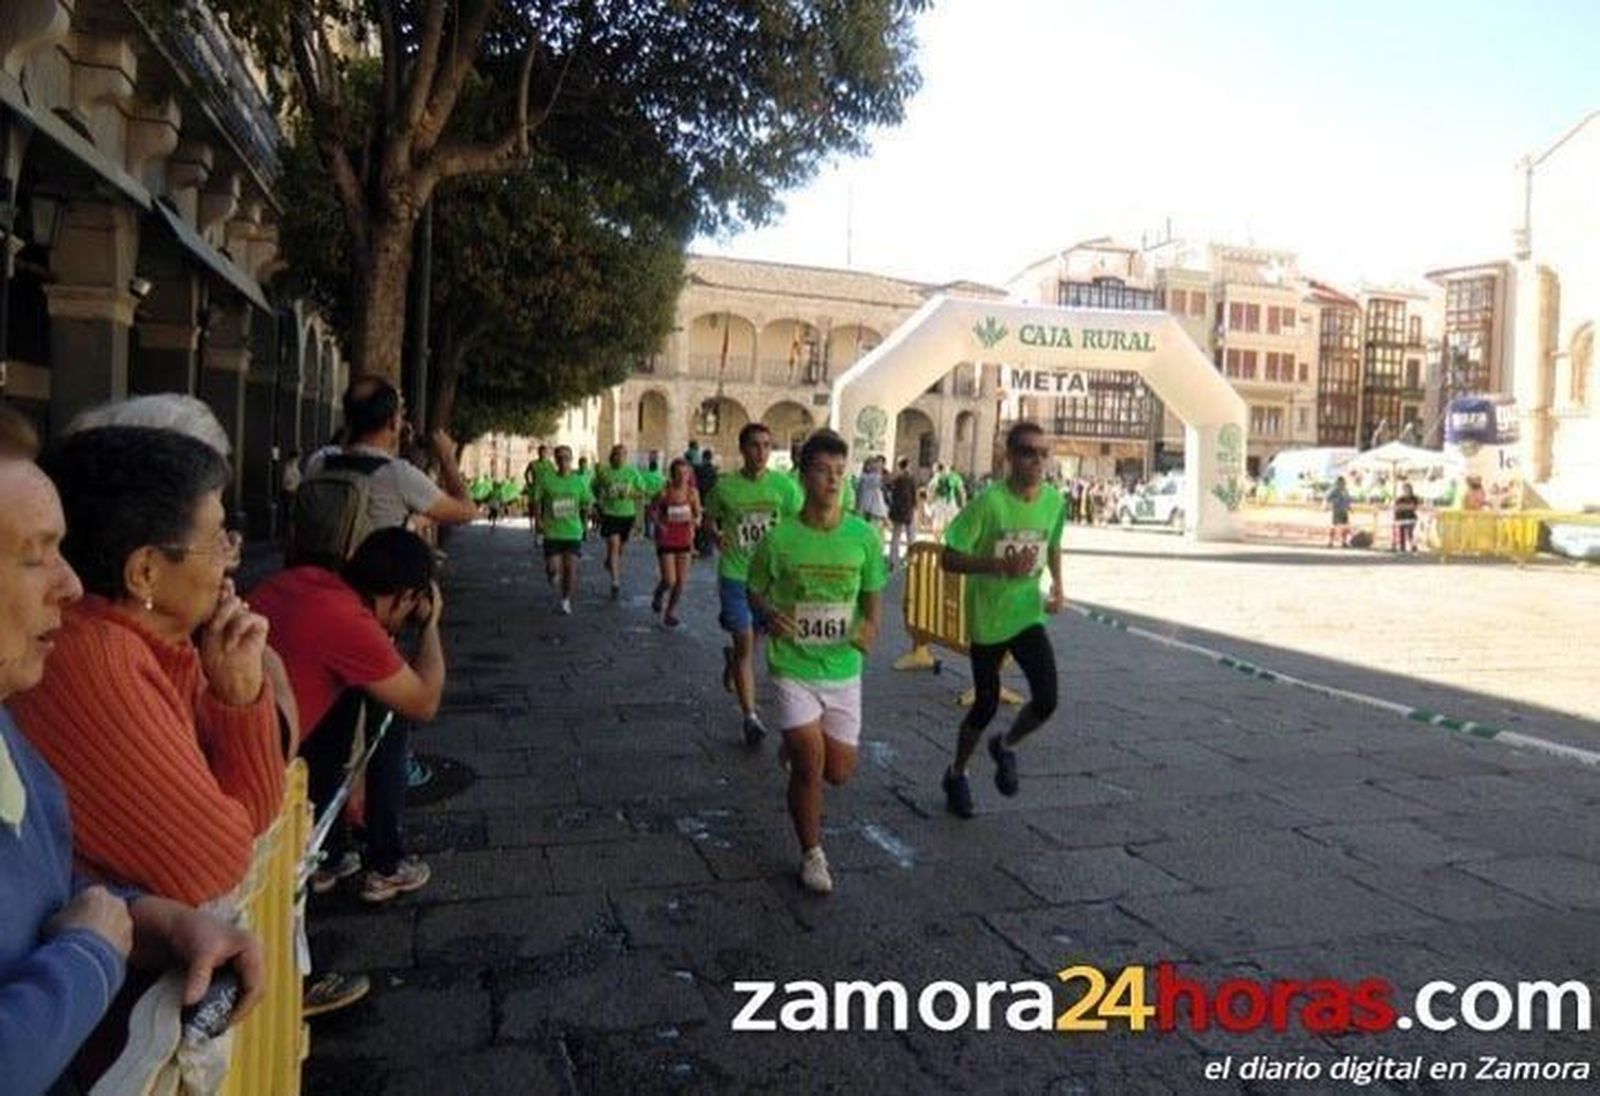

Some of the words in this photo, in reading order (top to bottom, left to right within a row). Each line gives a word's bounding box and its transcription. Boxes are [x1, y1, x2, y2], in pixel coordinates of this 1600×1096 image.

[1019, 324, 1072, 348] CAJA
[1082, 329, 1156, 352] RURAL
[1011, 369, 1085, 392] META
[798, 618, 846, 640] 3461
